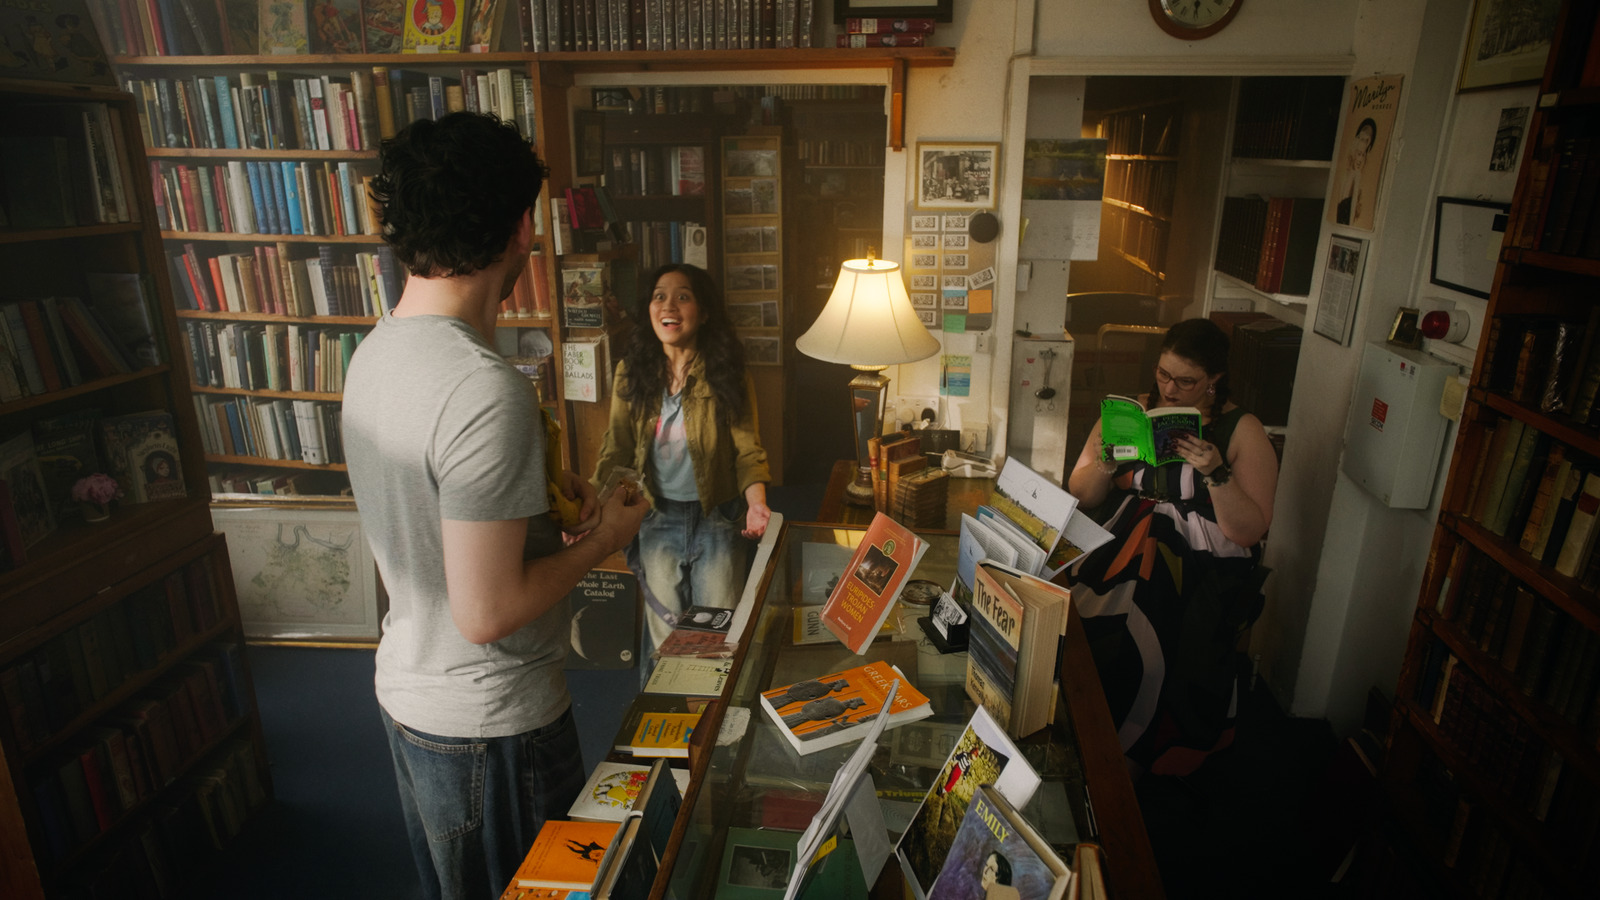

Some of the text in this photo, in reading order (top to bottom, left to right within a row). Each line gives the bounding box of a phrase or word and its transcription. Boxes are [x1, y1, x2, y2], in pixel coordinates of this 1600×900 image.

[1352, 80, 1395, 112] Marilyn
[565, 371, 594, 380] BALLADS
[600, 572, 617, 580] Last
[602, 582, 625, 590] Earth
[583, 589, 615, 598] Catalog
[846, 591, 868, 615] TROJAN
[840, 601, 864, 624] WOMEN
[976, 577, 1016, 637] The Fear
[807, 610, 818, 637] GUNN
[863, 666, 889, 690] GREEK
[974, 798, 1010, 844] EMILY
